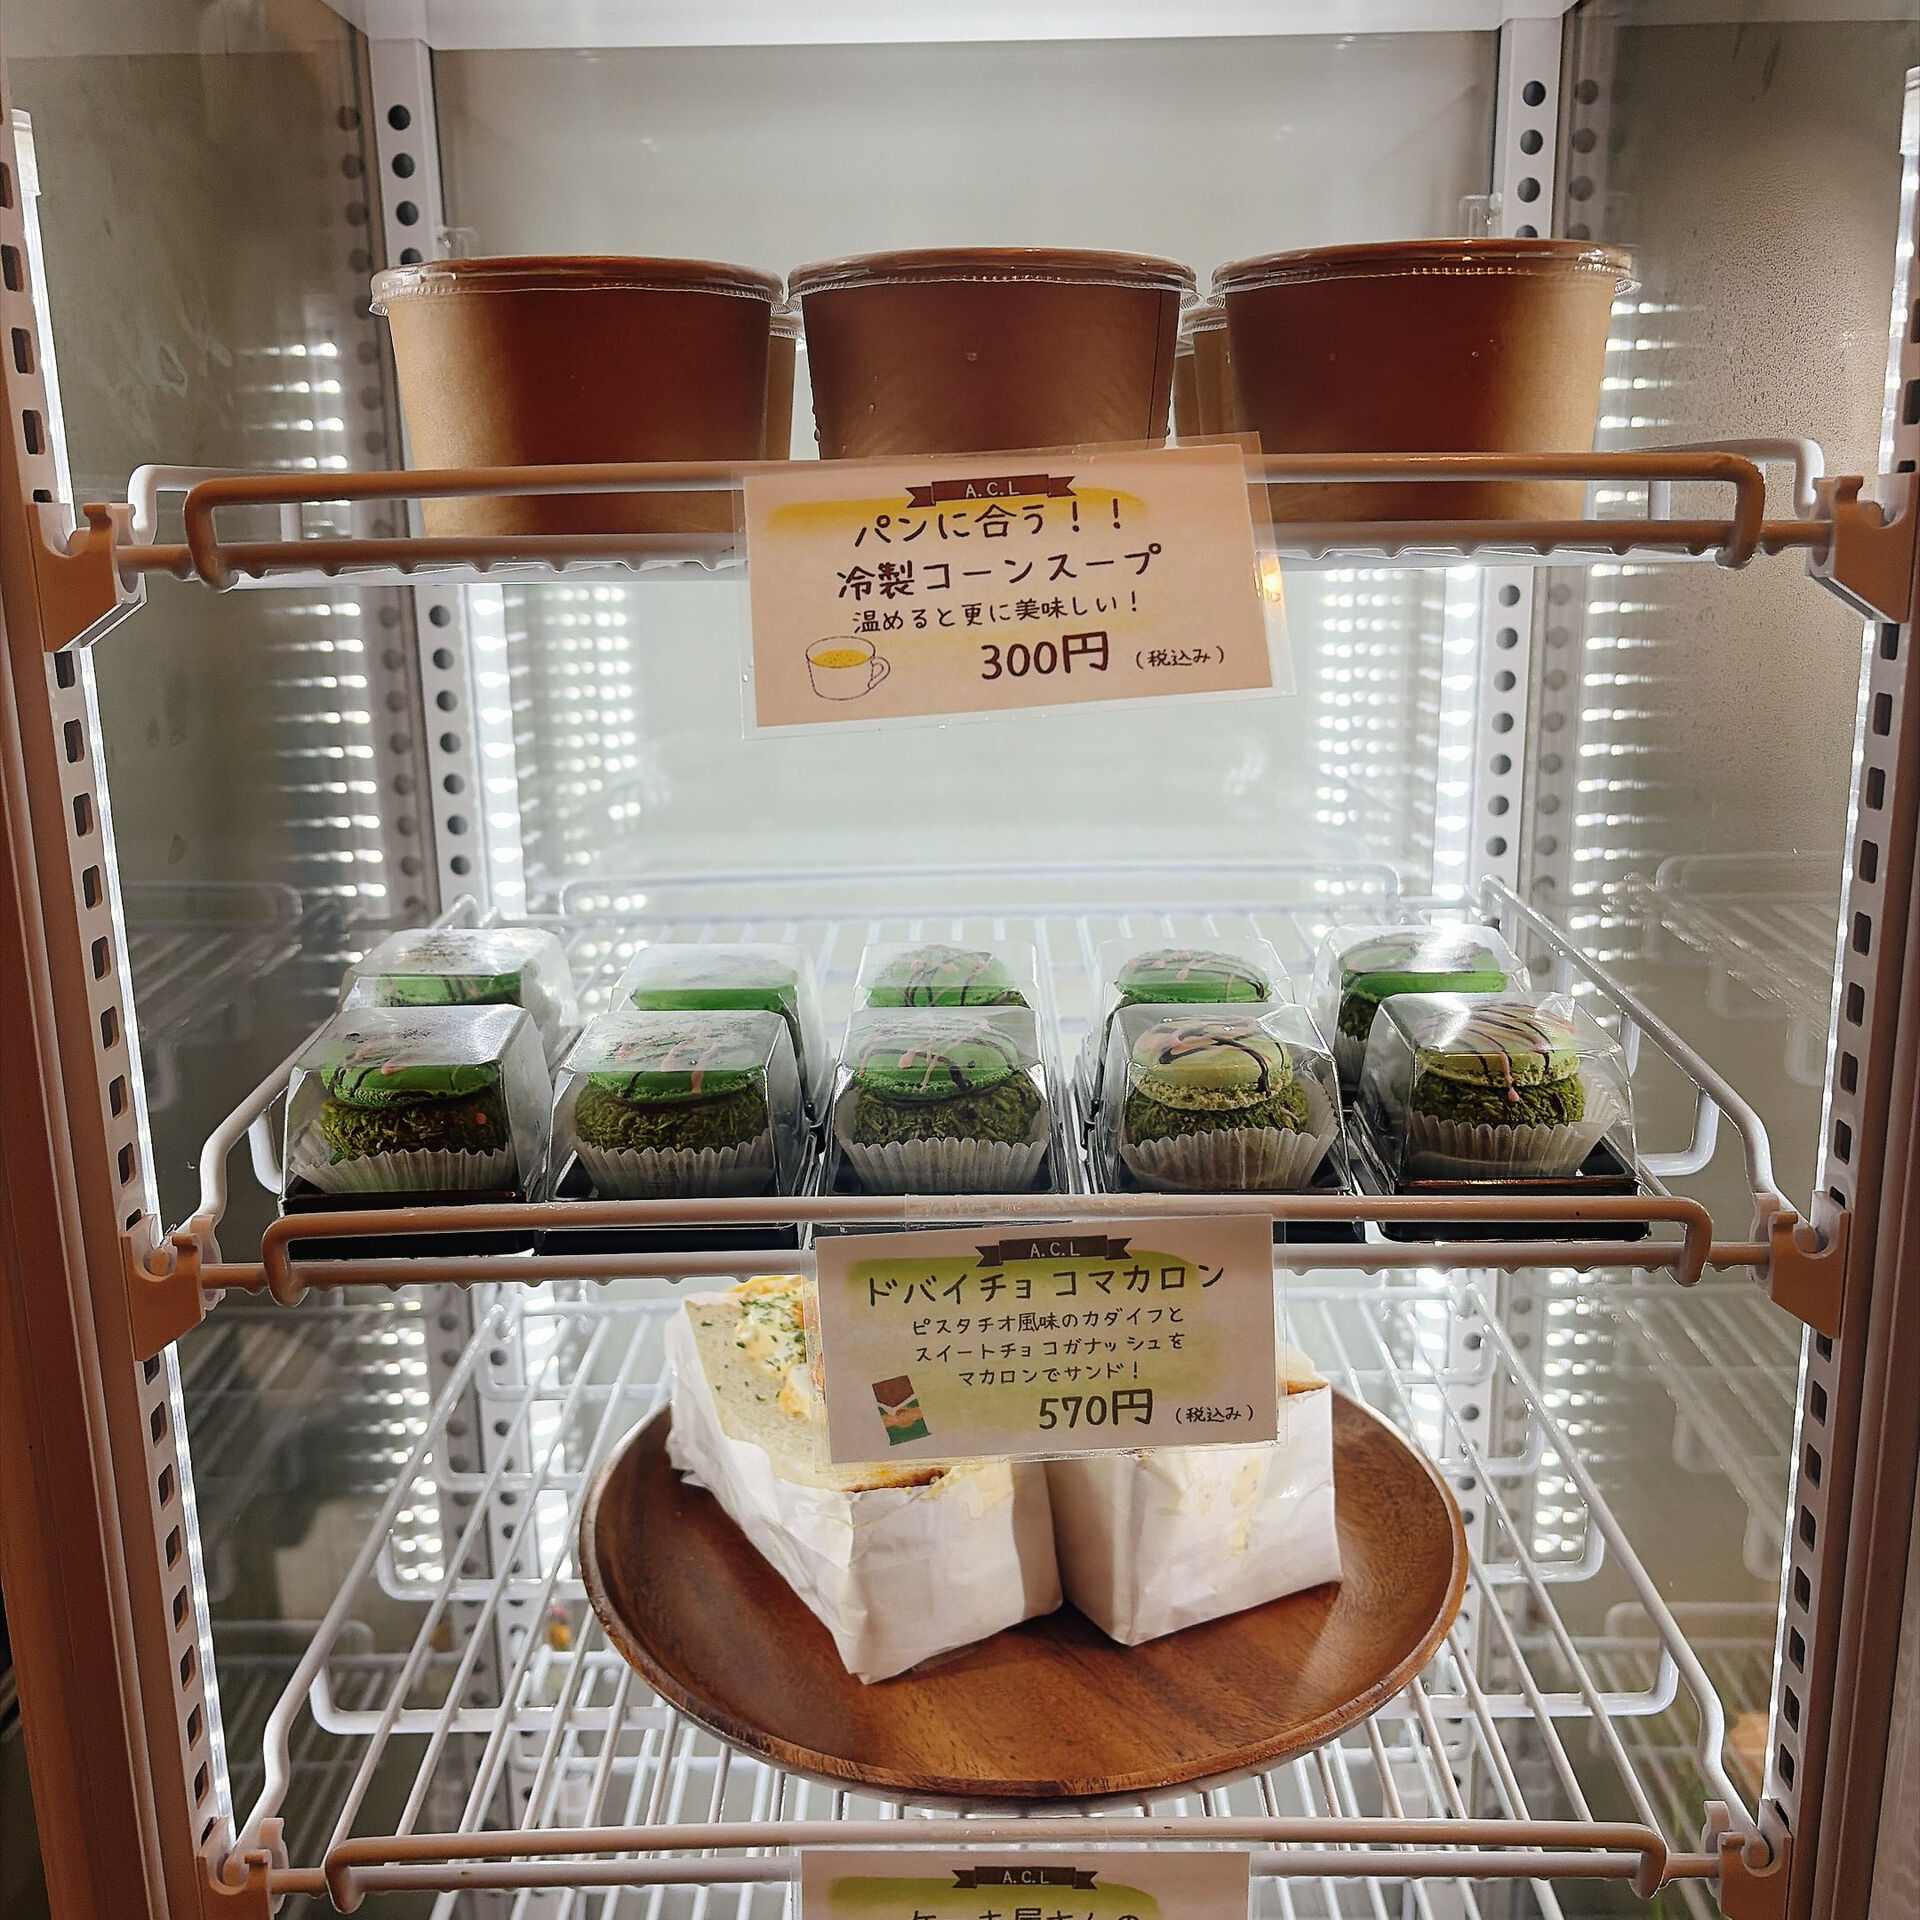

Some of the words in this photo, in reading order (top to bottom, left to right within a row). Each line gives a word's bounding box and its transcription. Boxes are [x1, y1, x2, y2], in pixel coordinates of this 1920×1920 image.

[966, 480, 1020, 498] A.C.L
[837, 543, 1162, 602] 冷製コーンスープ
[853, 591, 1137, 634] 温めると更に美味しい！
[981, 631, 1109, 680] 300円
[1031, 1242, 1081, 1258] A.C.L
[870, 1265, 1224, 1307] ドバイチョコマカロン
[913, 1307, 1184, 1336] ピスタチオ風味のカダイフと
[917, 1333, 1185, 1363] スイートチョコガナッシュを
[959, 1361, 1138, 1387] マカロンでサンド！
[1039, 1389, 1154, 1430] 570円
[1003, 1871, 1050, 1884] A.C.L
